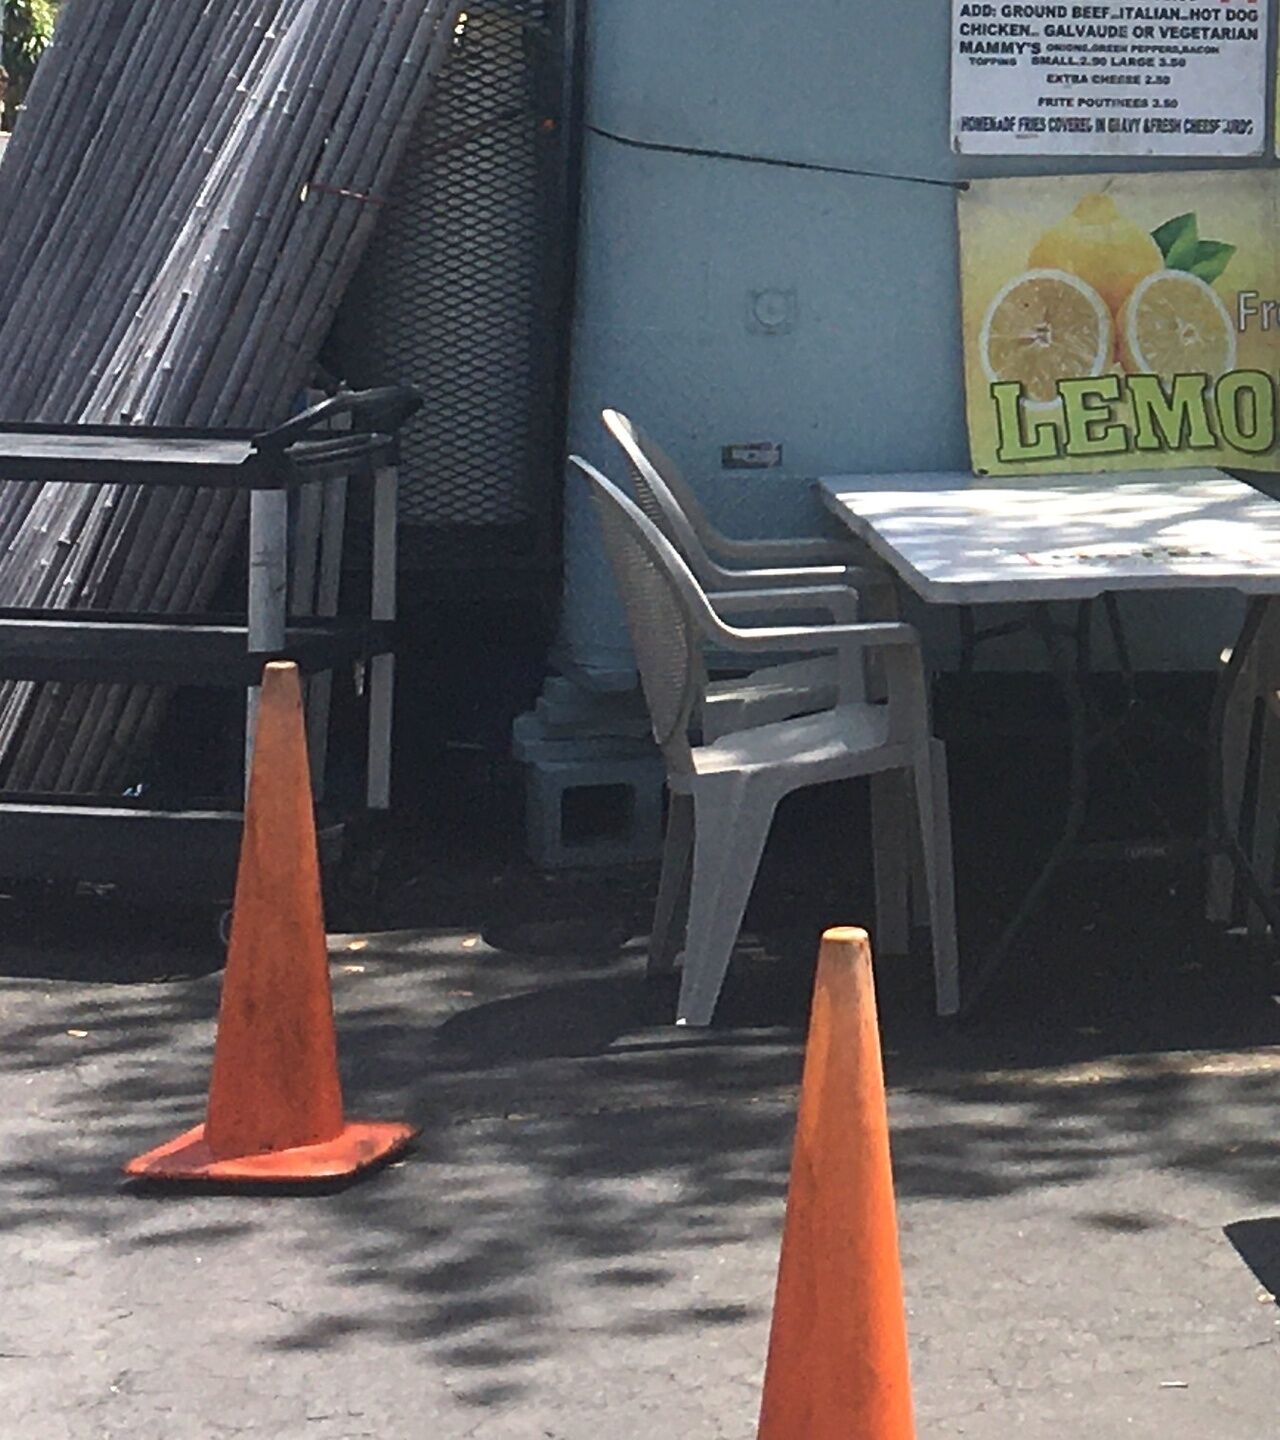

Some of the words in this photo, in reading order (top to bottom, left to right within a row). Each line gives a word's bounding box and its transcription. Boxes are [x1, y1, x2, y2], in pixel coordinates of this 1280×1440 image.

[960, 4, 996, 18] ADD:
[1001, 4, 1067, 19] GROUND
[1225, 9, 1259, 23] DOG
[1044, 24, 1128, 38] GALVAUDE
[1132, 26, 1155, 39] OR
[1158, 26, 1258, 40] VEGETARIAN
[960, 41, 1041, 55] MAMMY'S
[1111, 57, 1155, 67] LARGE
[1046, 74, 1088, 84] EXTRA
[1091, 74, 1141, 85] CHEESE
[1018, 116, 1047, 132] FRIES
